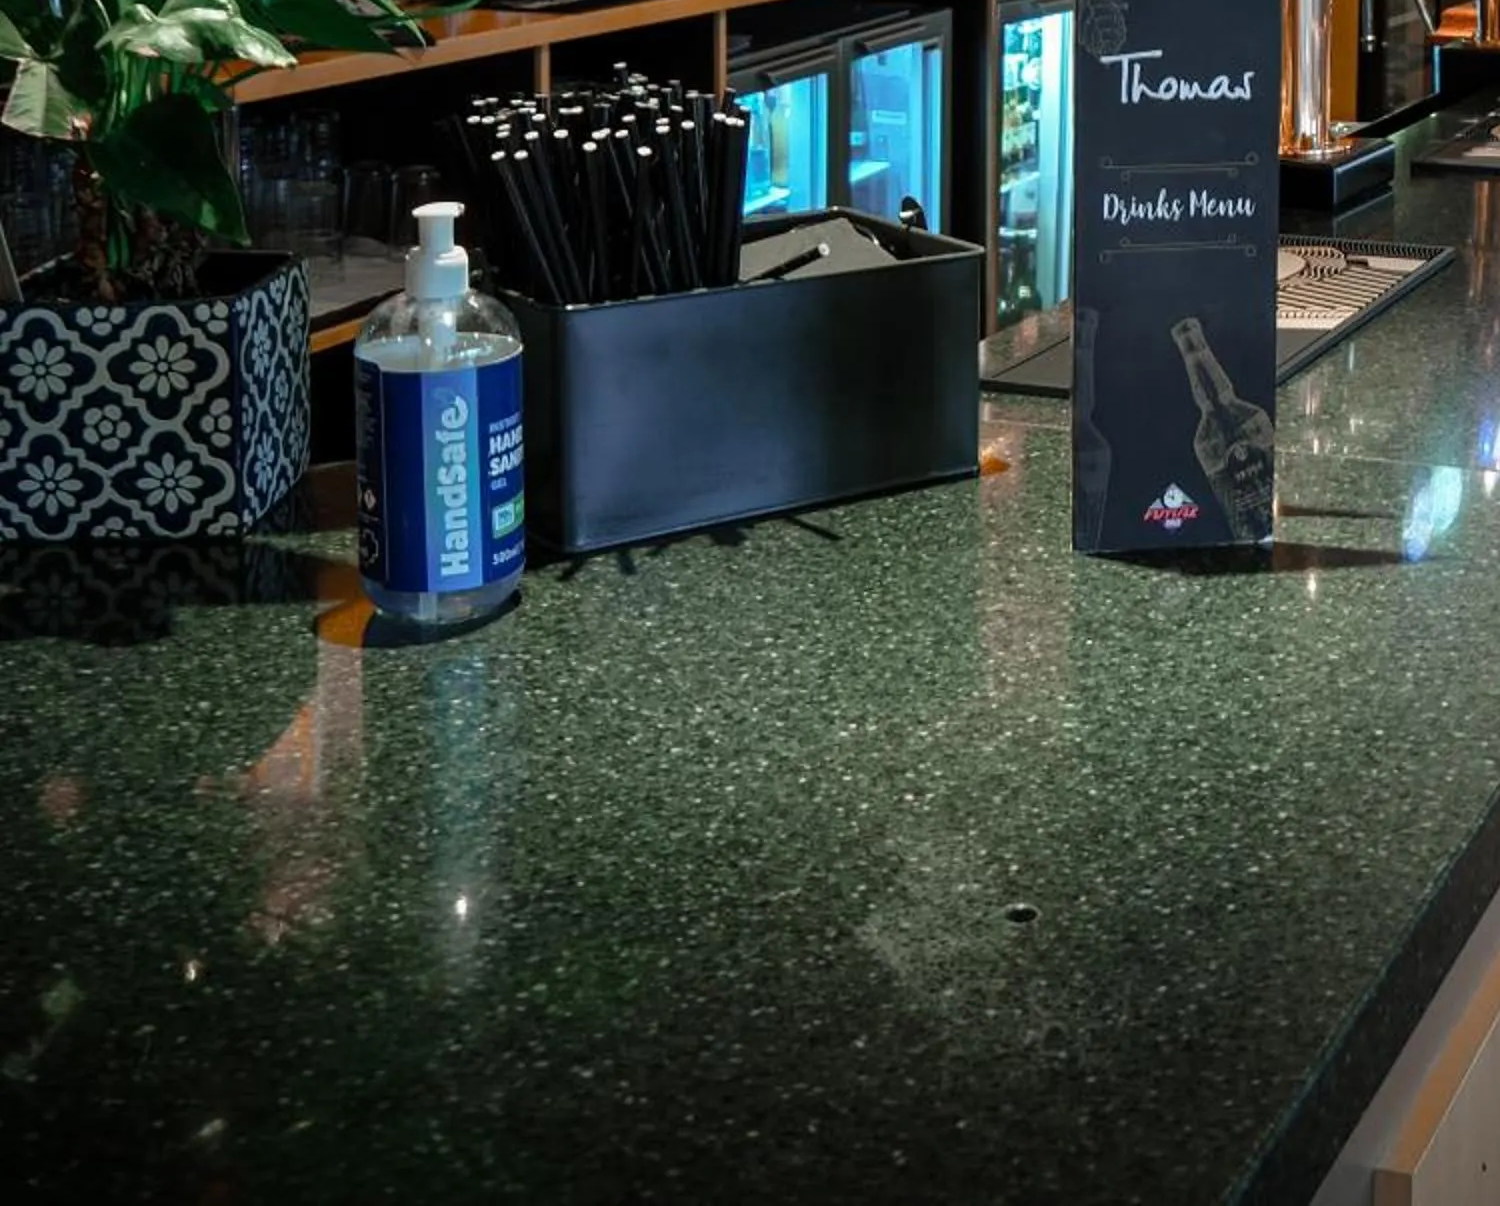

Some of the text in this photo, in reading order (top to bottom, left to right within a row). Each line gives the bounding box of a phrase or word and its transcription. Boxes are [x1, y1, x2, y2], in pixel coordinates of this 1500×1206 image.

[1100, 48, 1256, 104] Thomas
[1103, 188, 1256, 226] Drinks Menu
